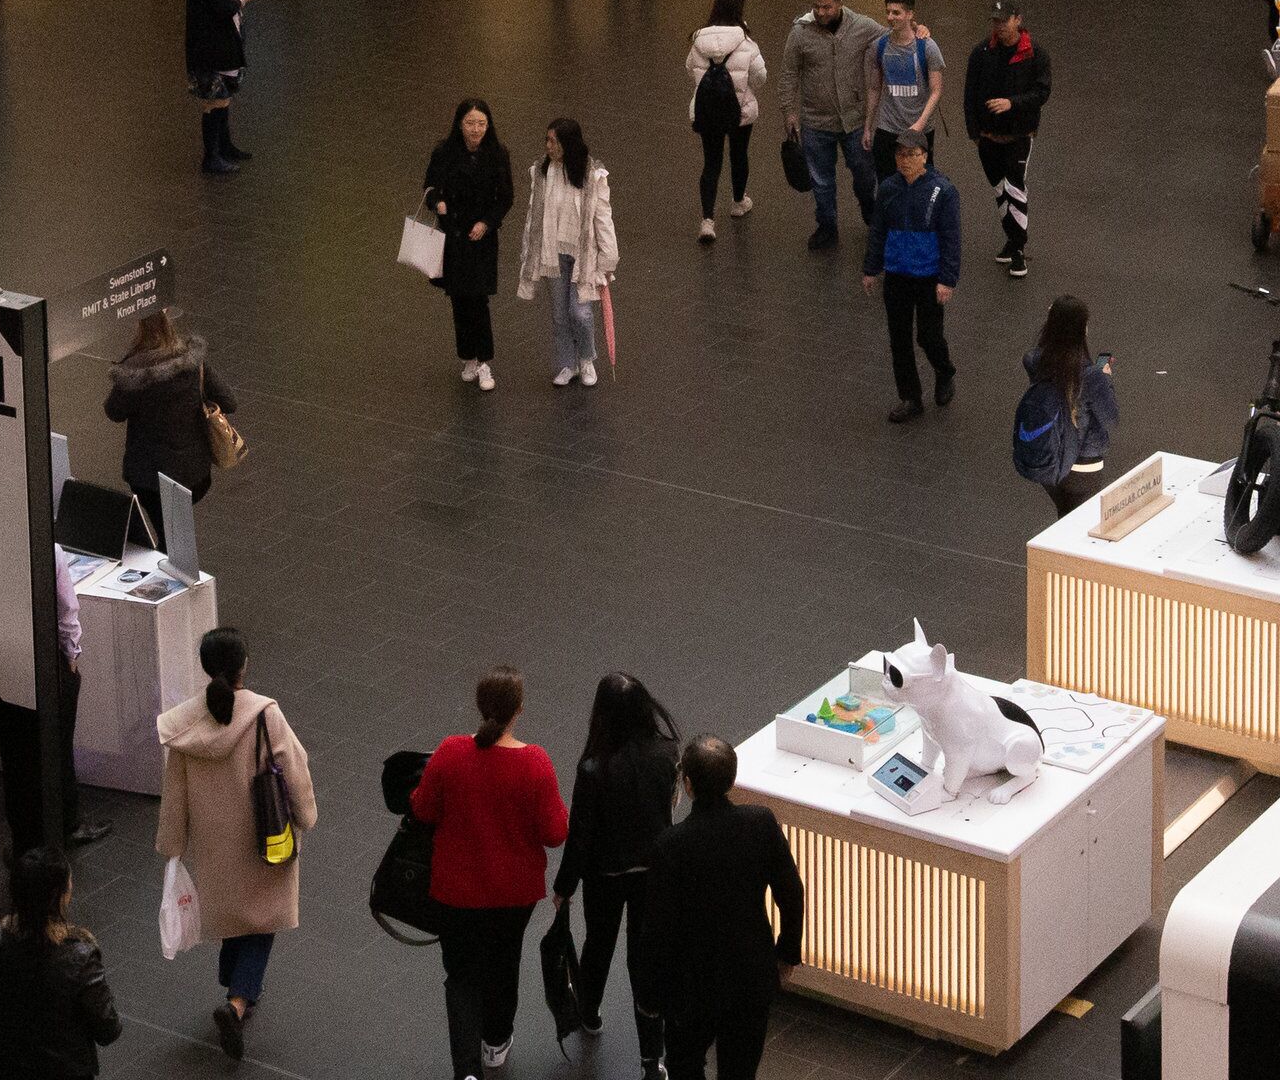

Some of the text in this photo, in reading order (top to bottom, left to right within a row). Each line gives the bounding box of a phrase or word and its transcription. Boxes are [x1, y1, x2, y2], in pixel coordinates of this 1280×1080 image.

[887, 85, 918, 97] PUMA
[110, 261, 154, 289] Swanston St
[82, 278, 156, 318] RMIT & State Library
[116, 294, 156, 319] Knox Place
